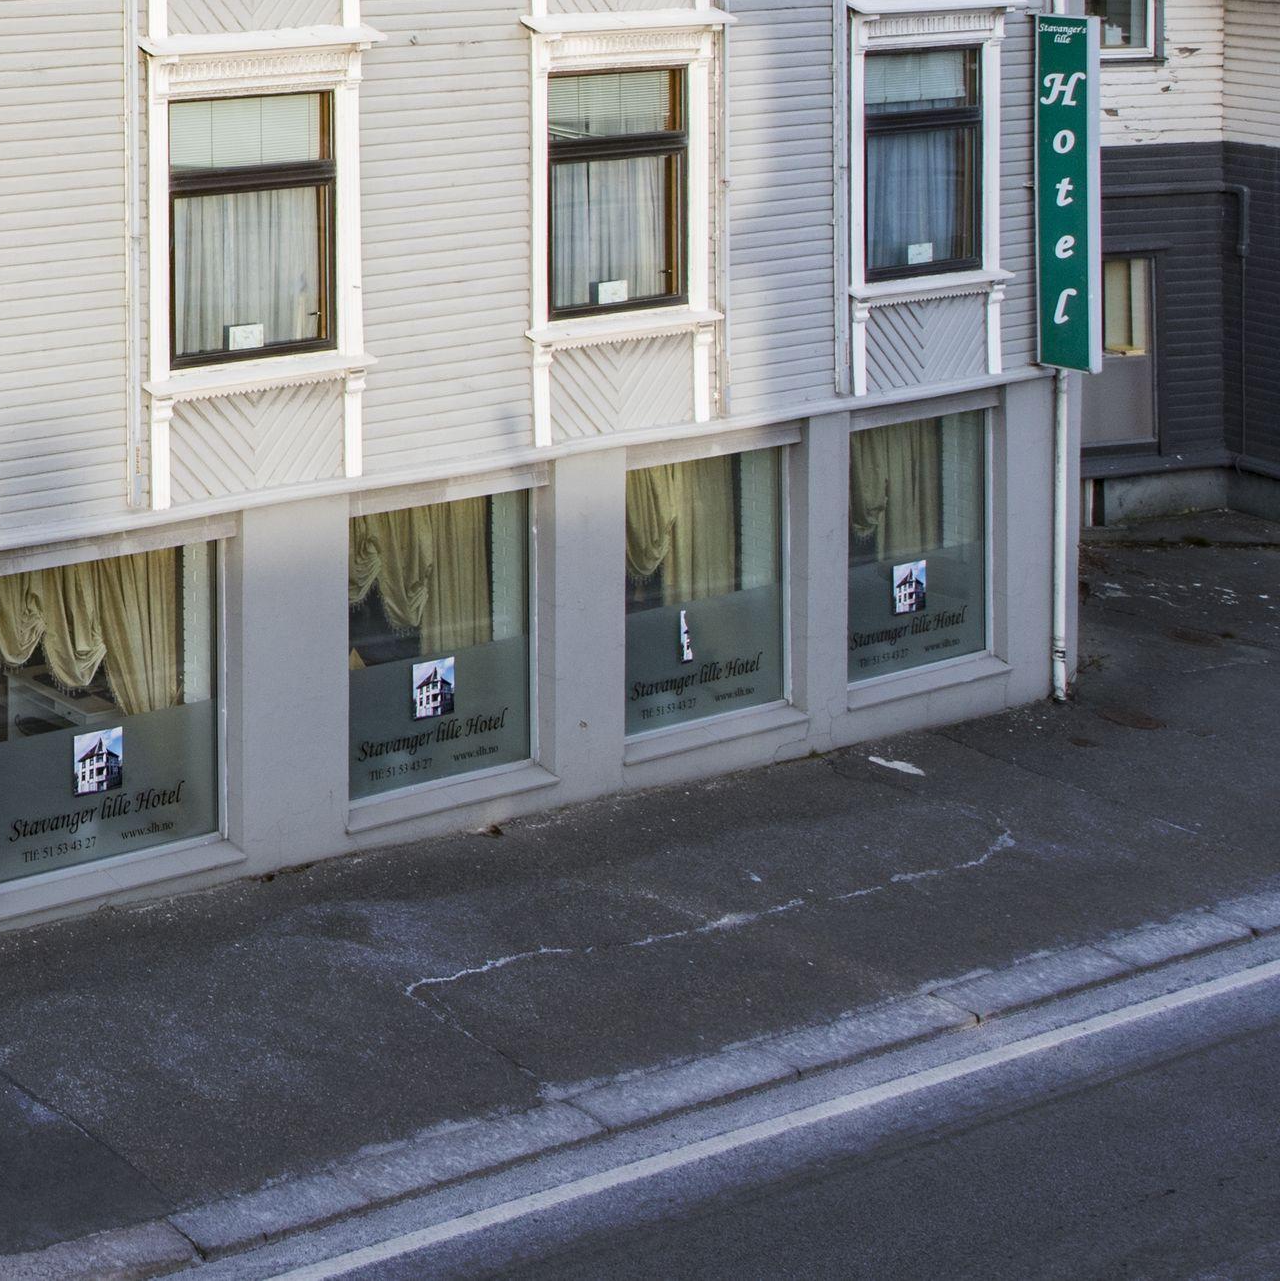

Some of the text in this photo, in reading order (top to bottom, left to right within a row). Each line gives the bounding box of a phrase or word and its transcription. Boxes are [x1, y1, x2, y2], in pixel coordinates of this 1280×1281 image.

[1039, 23, 1087, 36] Stavanger's
[1054, 34, 1071, 44] lille
[1040, 72, 1086, 324] Hotel
[850, 605, 967, 651] Stavanger lille Hotel
[631, 651, 763, 701] Stavanger lille Hotel
[358, 707, 508, 762] Stavanger lille Hotel
[9, 780, 185, 842] Stavanger lille Hotel
[121, 821, 174, 840] www.slh.no
[43, 846, 54, 859] 51
[56, 843, 68, 856] 53
[71, 839, 82, 852] 43
[85, 836, 96, 849] 27
